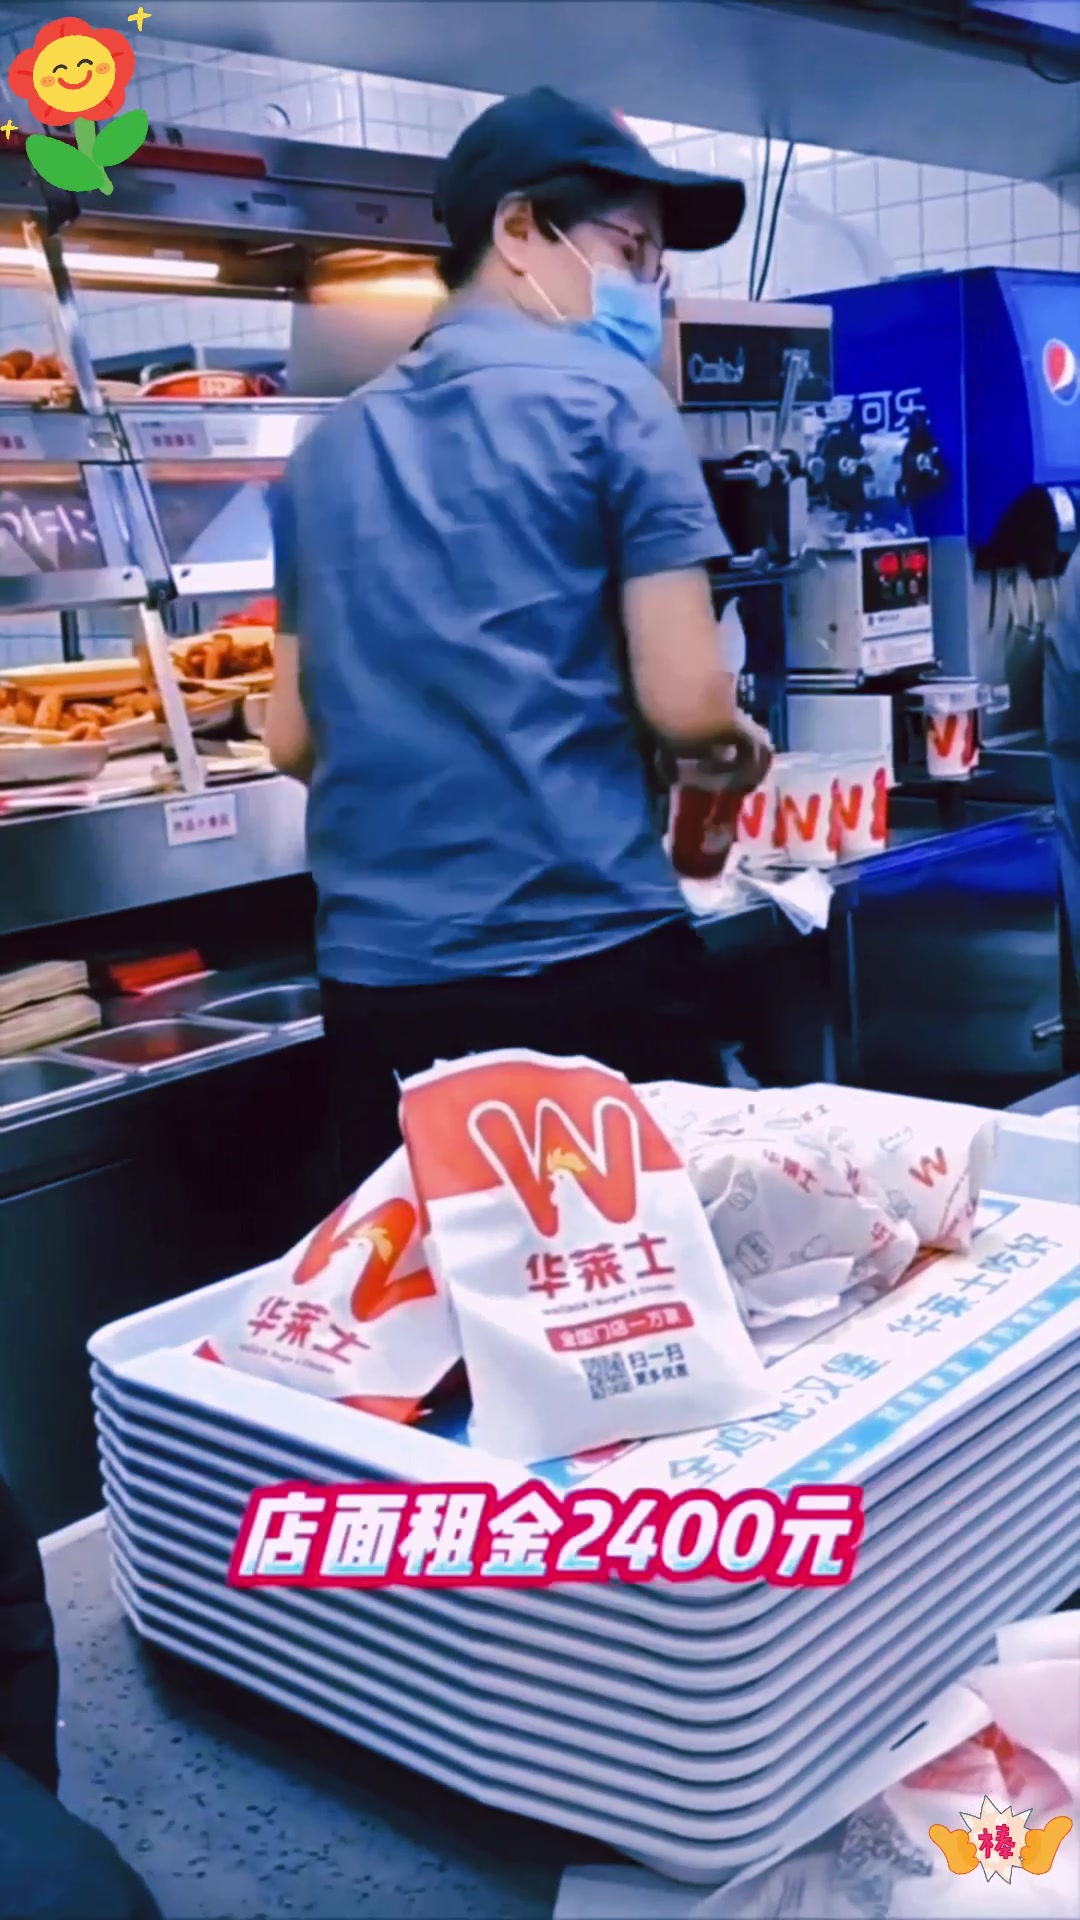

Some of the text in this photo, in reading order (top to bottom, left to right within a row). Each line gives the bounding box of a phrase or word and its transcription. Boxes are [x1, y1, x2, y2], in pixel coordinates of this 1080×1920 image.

[467, 1095, 643, 1239] W
[908, 1145, 949, 1188] W
[526, 1232, 676, 1300] 华莱士
[247, 1295, 371, 1364] 华莱士
[628, 1342, 685, 1370] 扫一扫
[634, 1363, 689, 1387] 更多优惠
